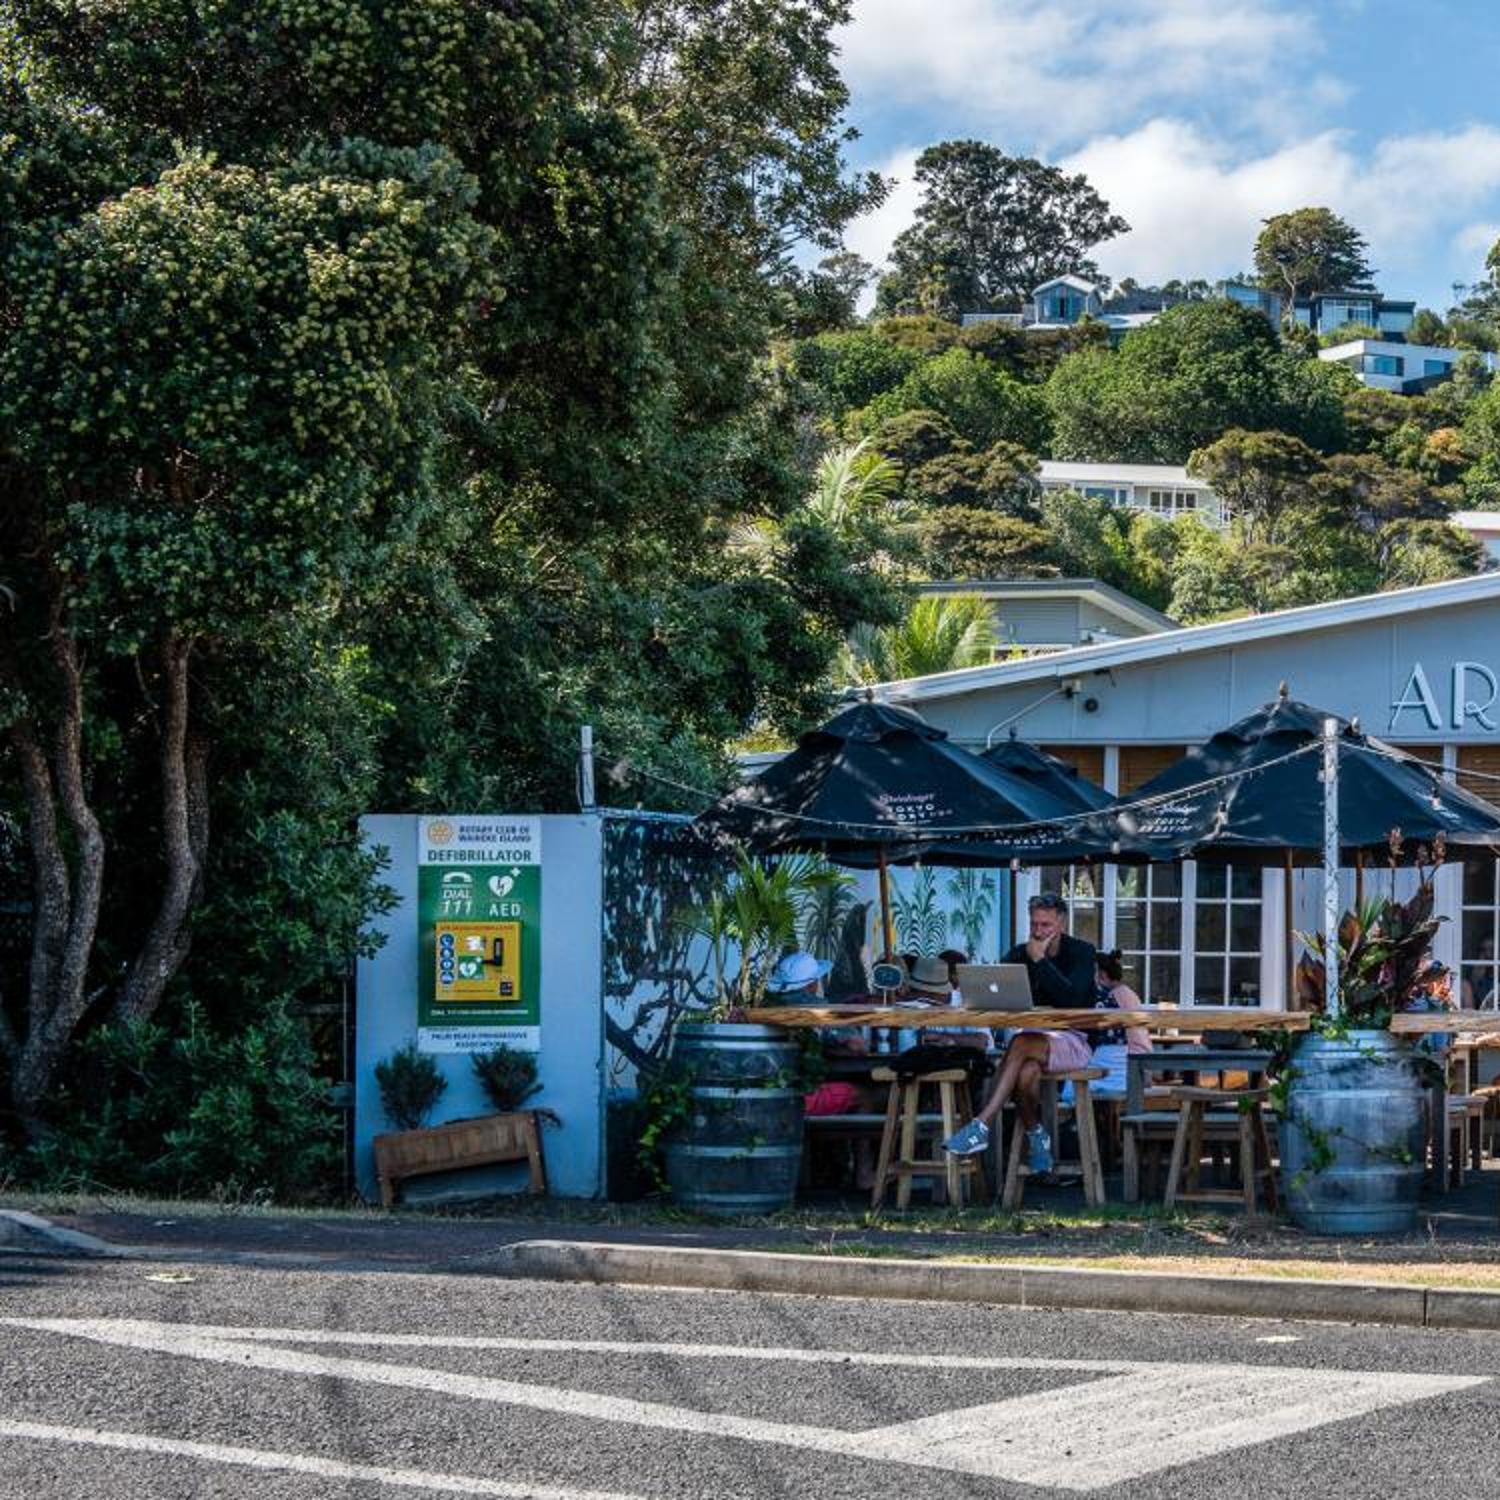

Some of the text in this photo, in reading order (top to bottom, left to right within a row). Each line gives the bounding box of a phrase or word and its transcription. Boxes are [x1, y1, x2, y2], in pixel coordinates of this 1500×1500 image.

[427, 849, 532, 862] DEFIBRILLATOR
[443, 889, 473, 899] DIAL
[442, 900, 473, 914] 111
[489, 903, 521, 917] AED
